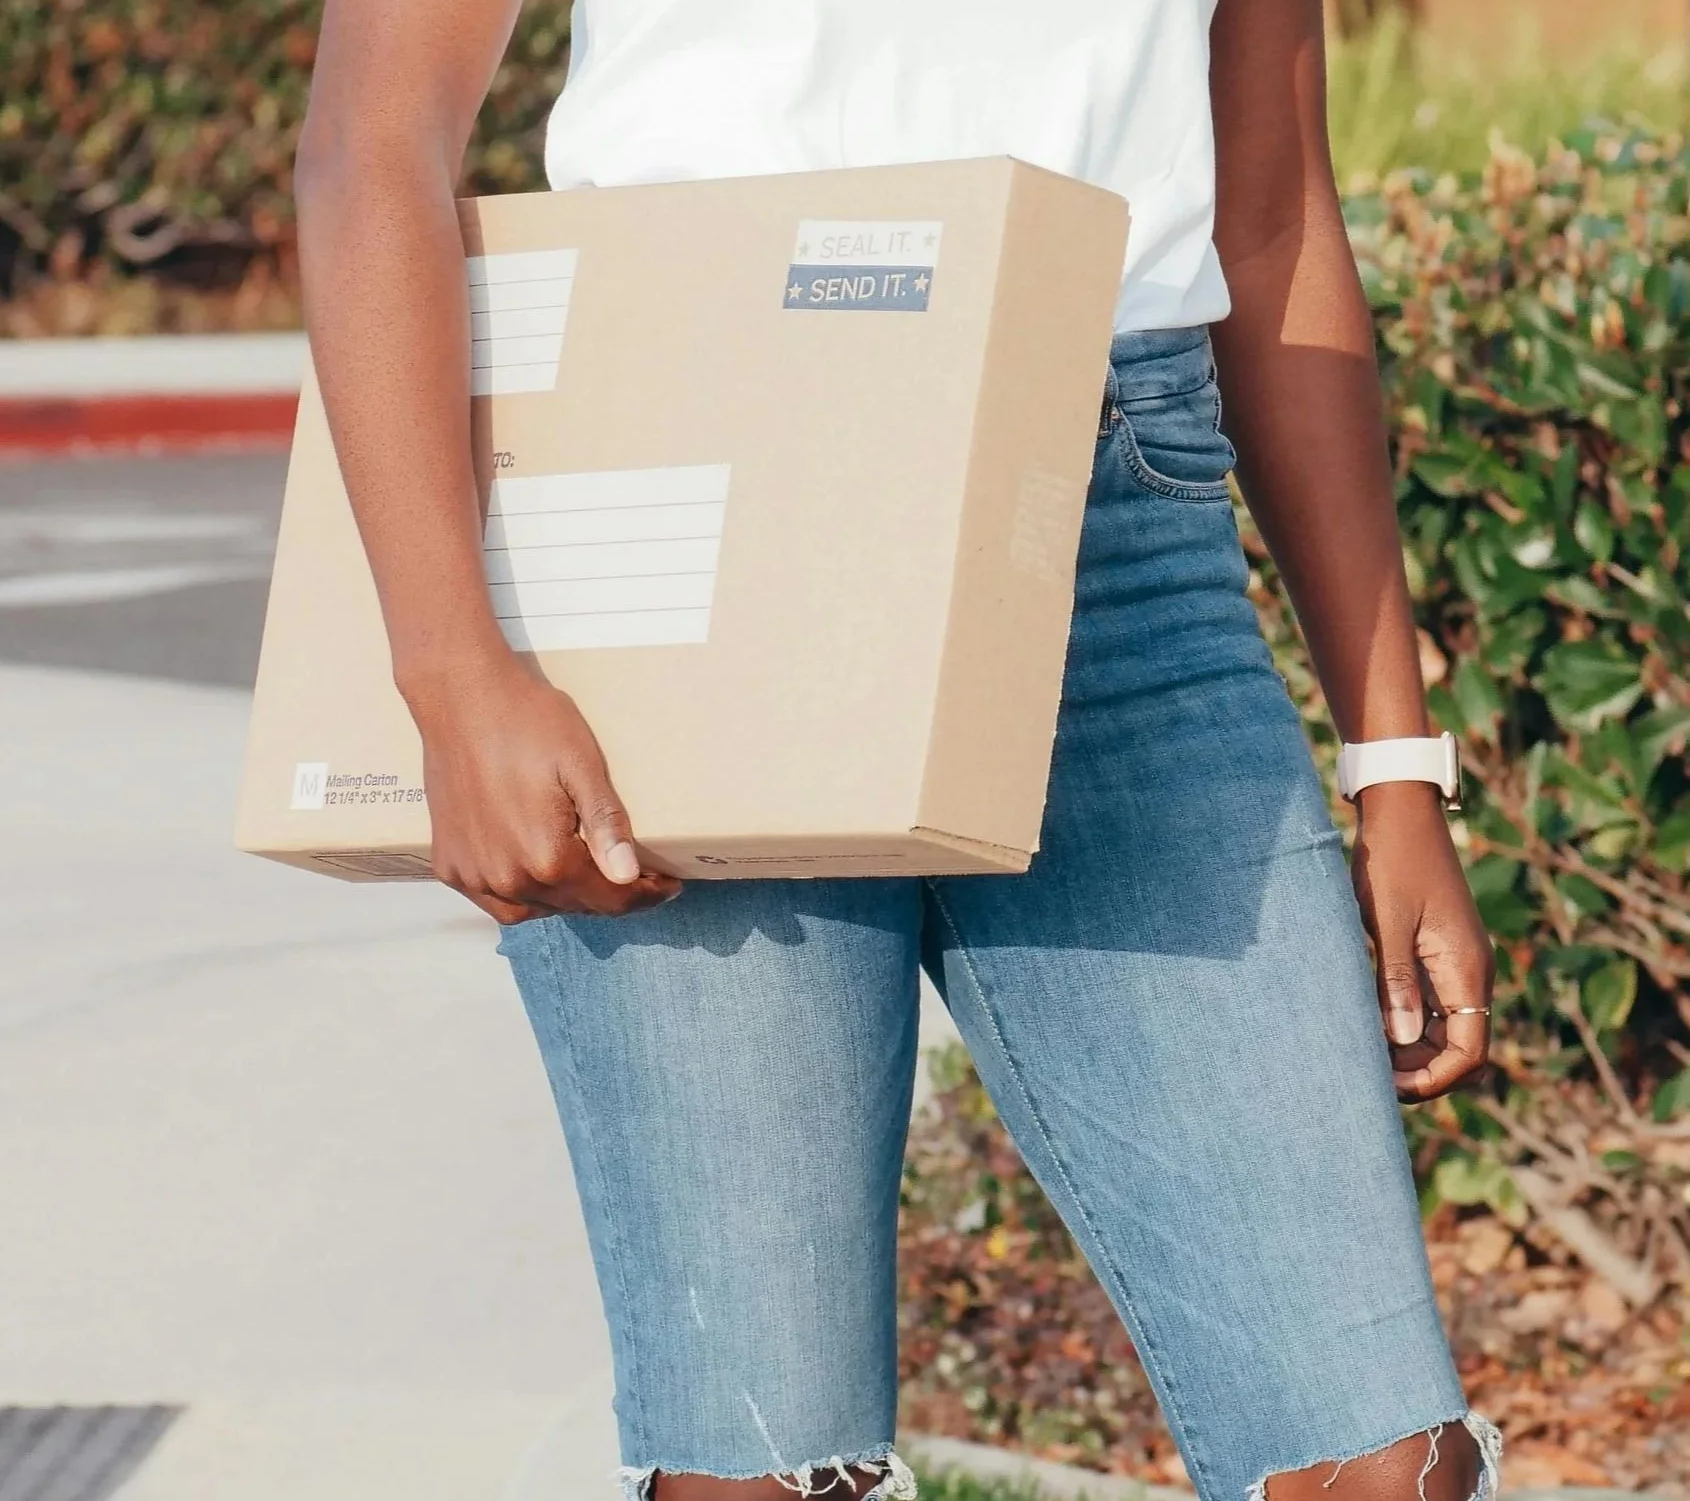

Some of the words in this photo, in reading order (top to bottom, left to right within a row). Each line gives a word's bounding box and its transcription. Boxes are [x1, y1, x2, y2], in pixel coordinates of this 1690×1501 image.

[819, 233, 880, 259] SEAL
[888, 231, 913, 253] IT.
[809, 276, 876, 302] SEND
[882, 274, 906, 297] IT.
[493, 452, 515, 468] TO:
[300, 773, 320, 797] M
[326, 775, 362, 789] Mailing
[364, 773, 398, 787] Carton
[324, 791, 337, 805] 12
[360, 793, 368, 804] x
[383, 792, 390, 803] x
[392, 789, 405, 803] 17
